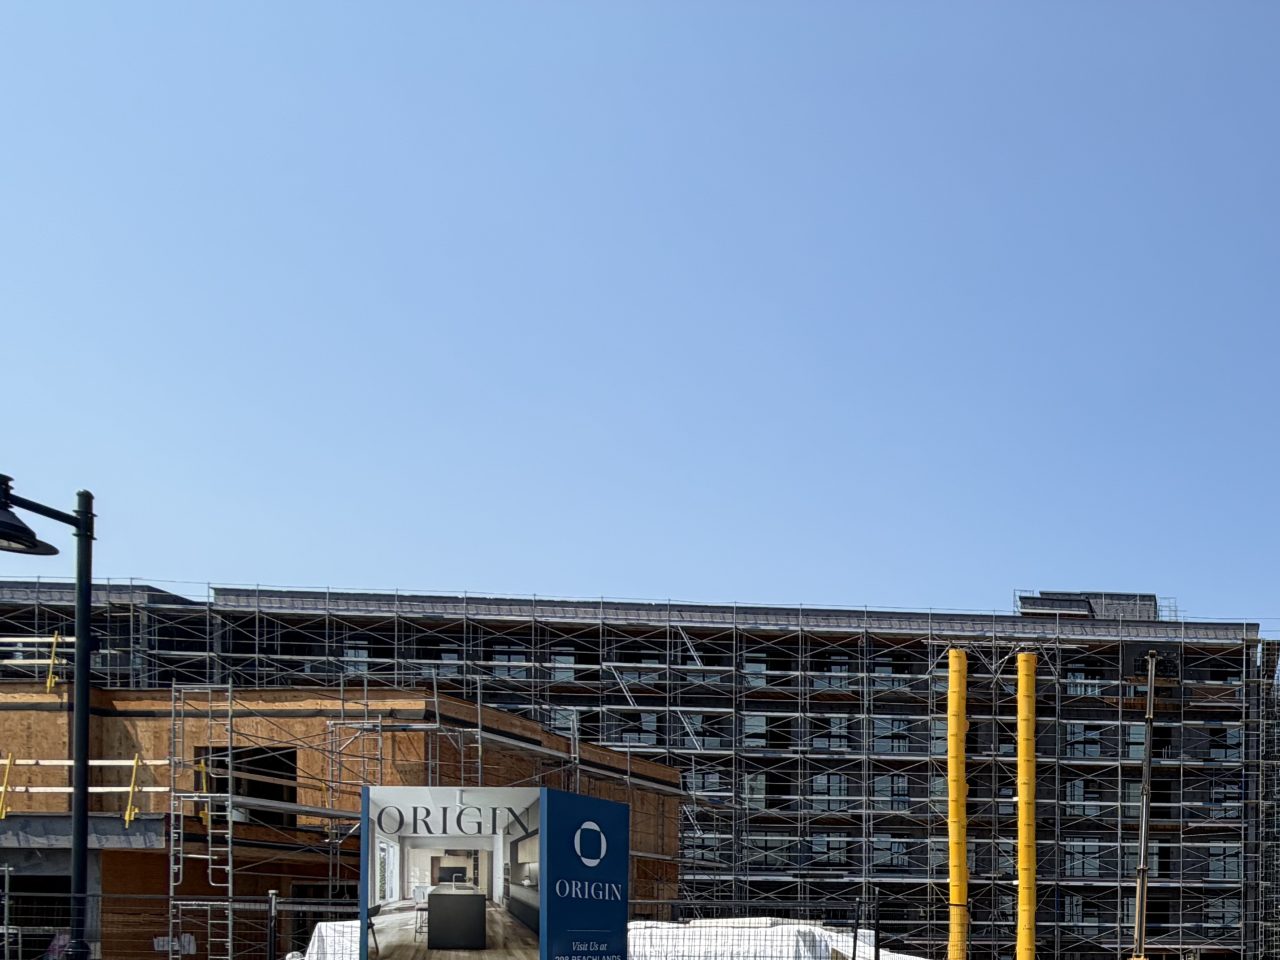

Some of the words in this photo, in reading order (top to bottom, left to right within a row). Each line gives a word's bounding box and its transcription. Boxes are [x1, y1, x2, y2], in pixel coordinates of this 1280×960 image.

[377, 805, 530, 836] ORIGIN
[555, 879, 622, 901] ORIGIN
[572, 941, 589, 951] Visit
[589, 941, 599, 951] Us
[600, 943, 608, 951] at
